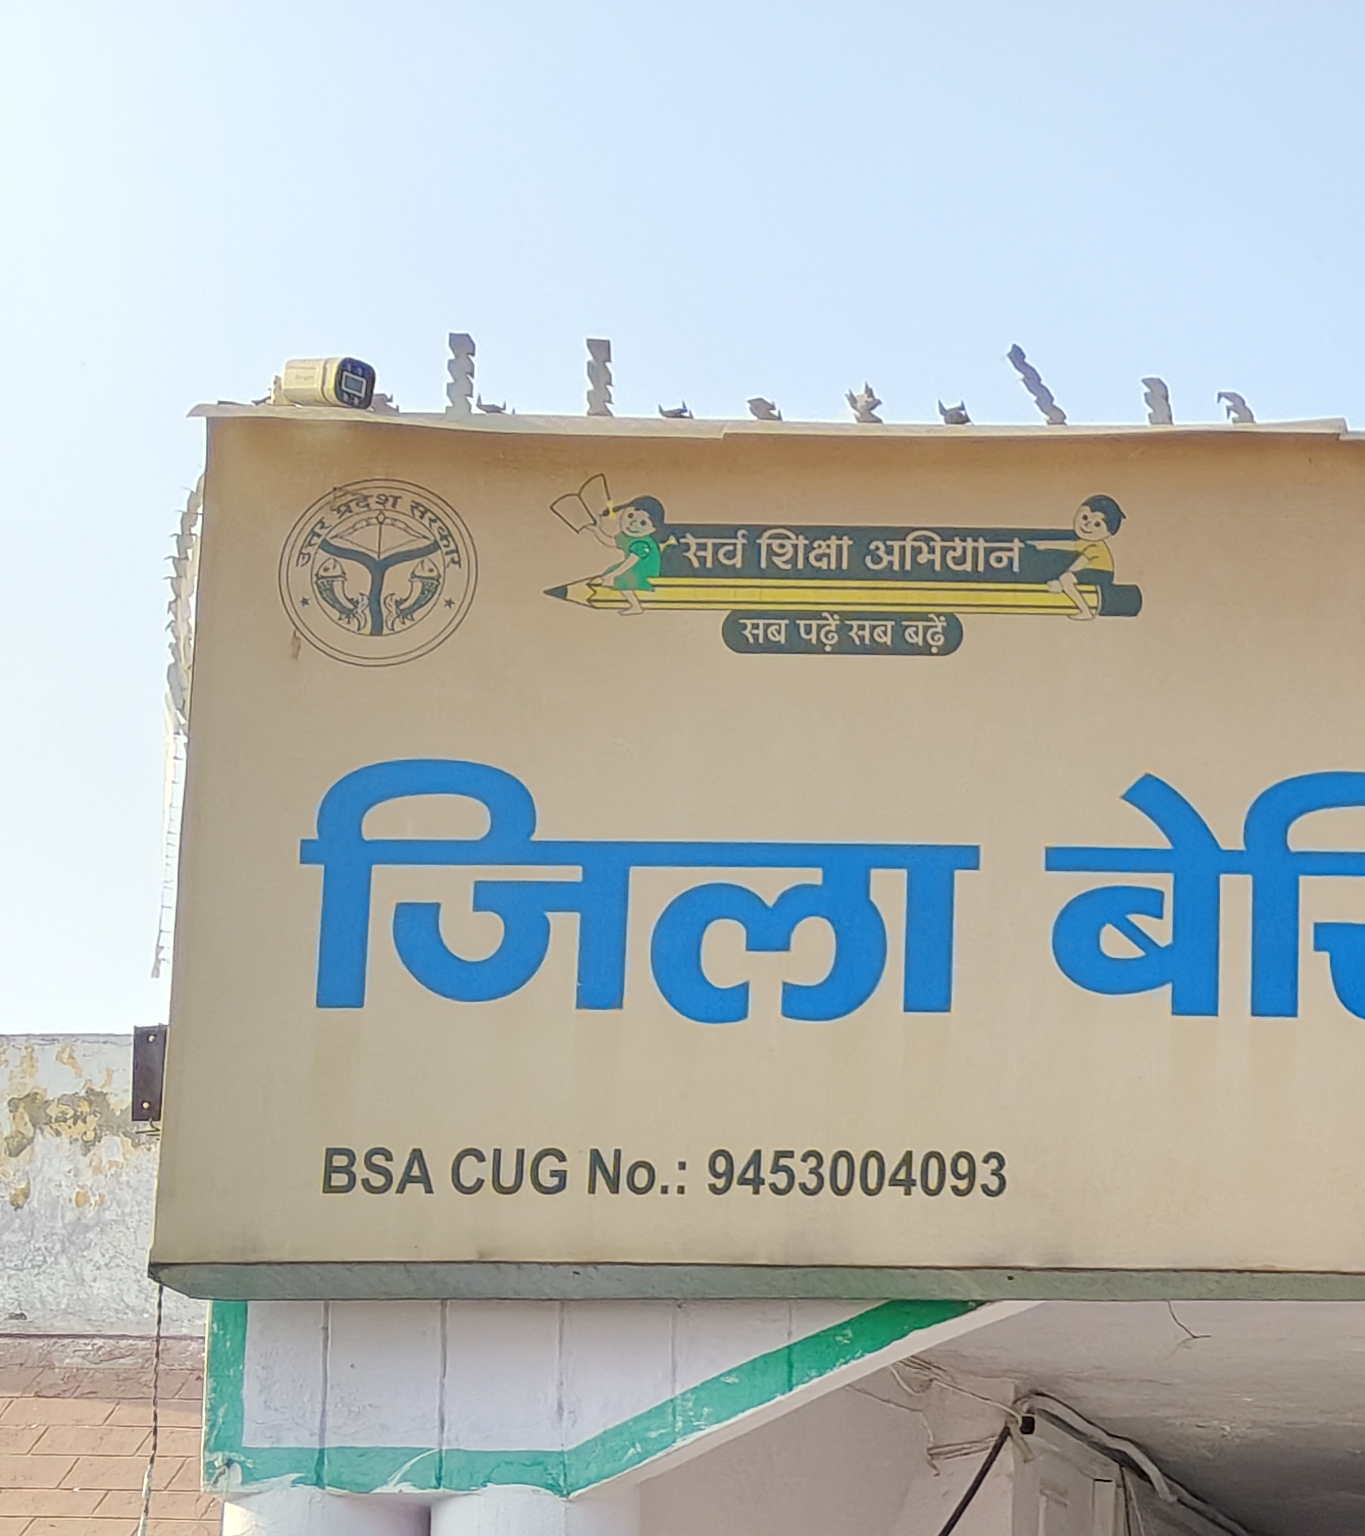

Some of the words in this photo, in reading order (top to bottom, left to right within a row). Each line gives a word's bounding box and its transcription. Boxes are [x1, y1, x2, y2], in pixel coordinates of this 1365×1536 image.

[410, 500, 462, 569] सरकार
[679, 529, 747, 568] सर्व
[756, 527, 853, 571] शिक्षा
[865, 529, 1025, 572] अभियान
[738, 618, 788, 646] सब
[797, 613, 840, 652] पढ़ें
[846, 619, 895, 646] सब
[902, 614, 948, 653] बढ़ें
[300, 757, 980, 1024] जिला
[322, 1146, 434, 1195] BSA
[450, 1147, 568, 1196] CUG
[706, 1149, 1008, 1197] 9453004093
